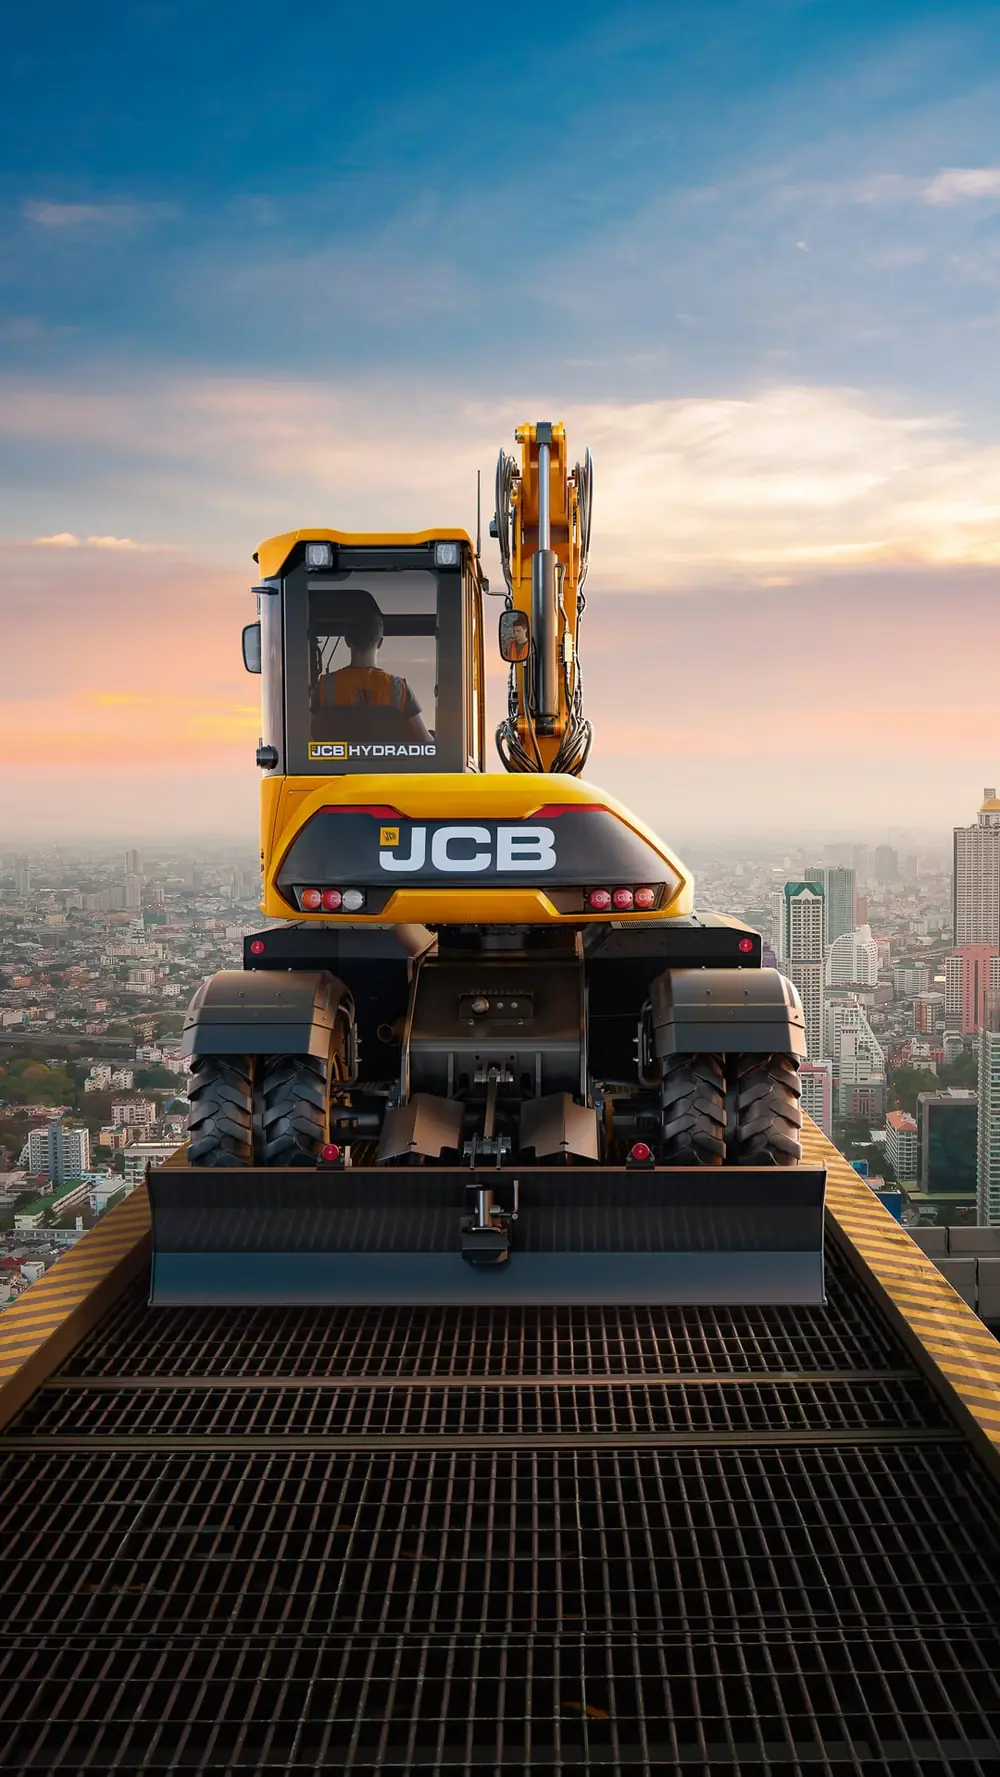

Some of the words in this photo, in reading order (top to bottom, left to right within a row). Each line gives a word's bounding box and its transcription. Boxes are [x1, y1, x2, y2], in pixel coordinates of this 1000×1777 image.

[311, 745, 345, 756] JCB
[348, 745, 437, 756] HYDRADIG
[379, 827, 557, 871] JCB
